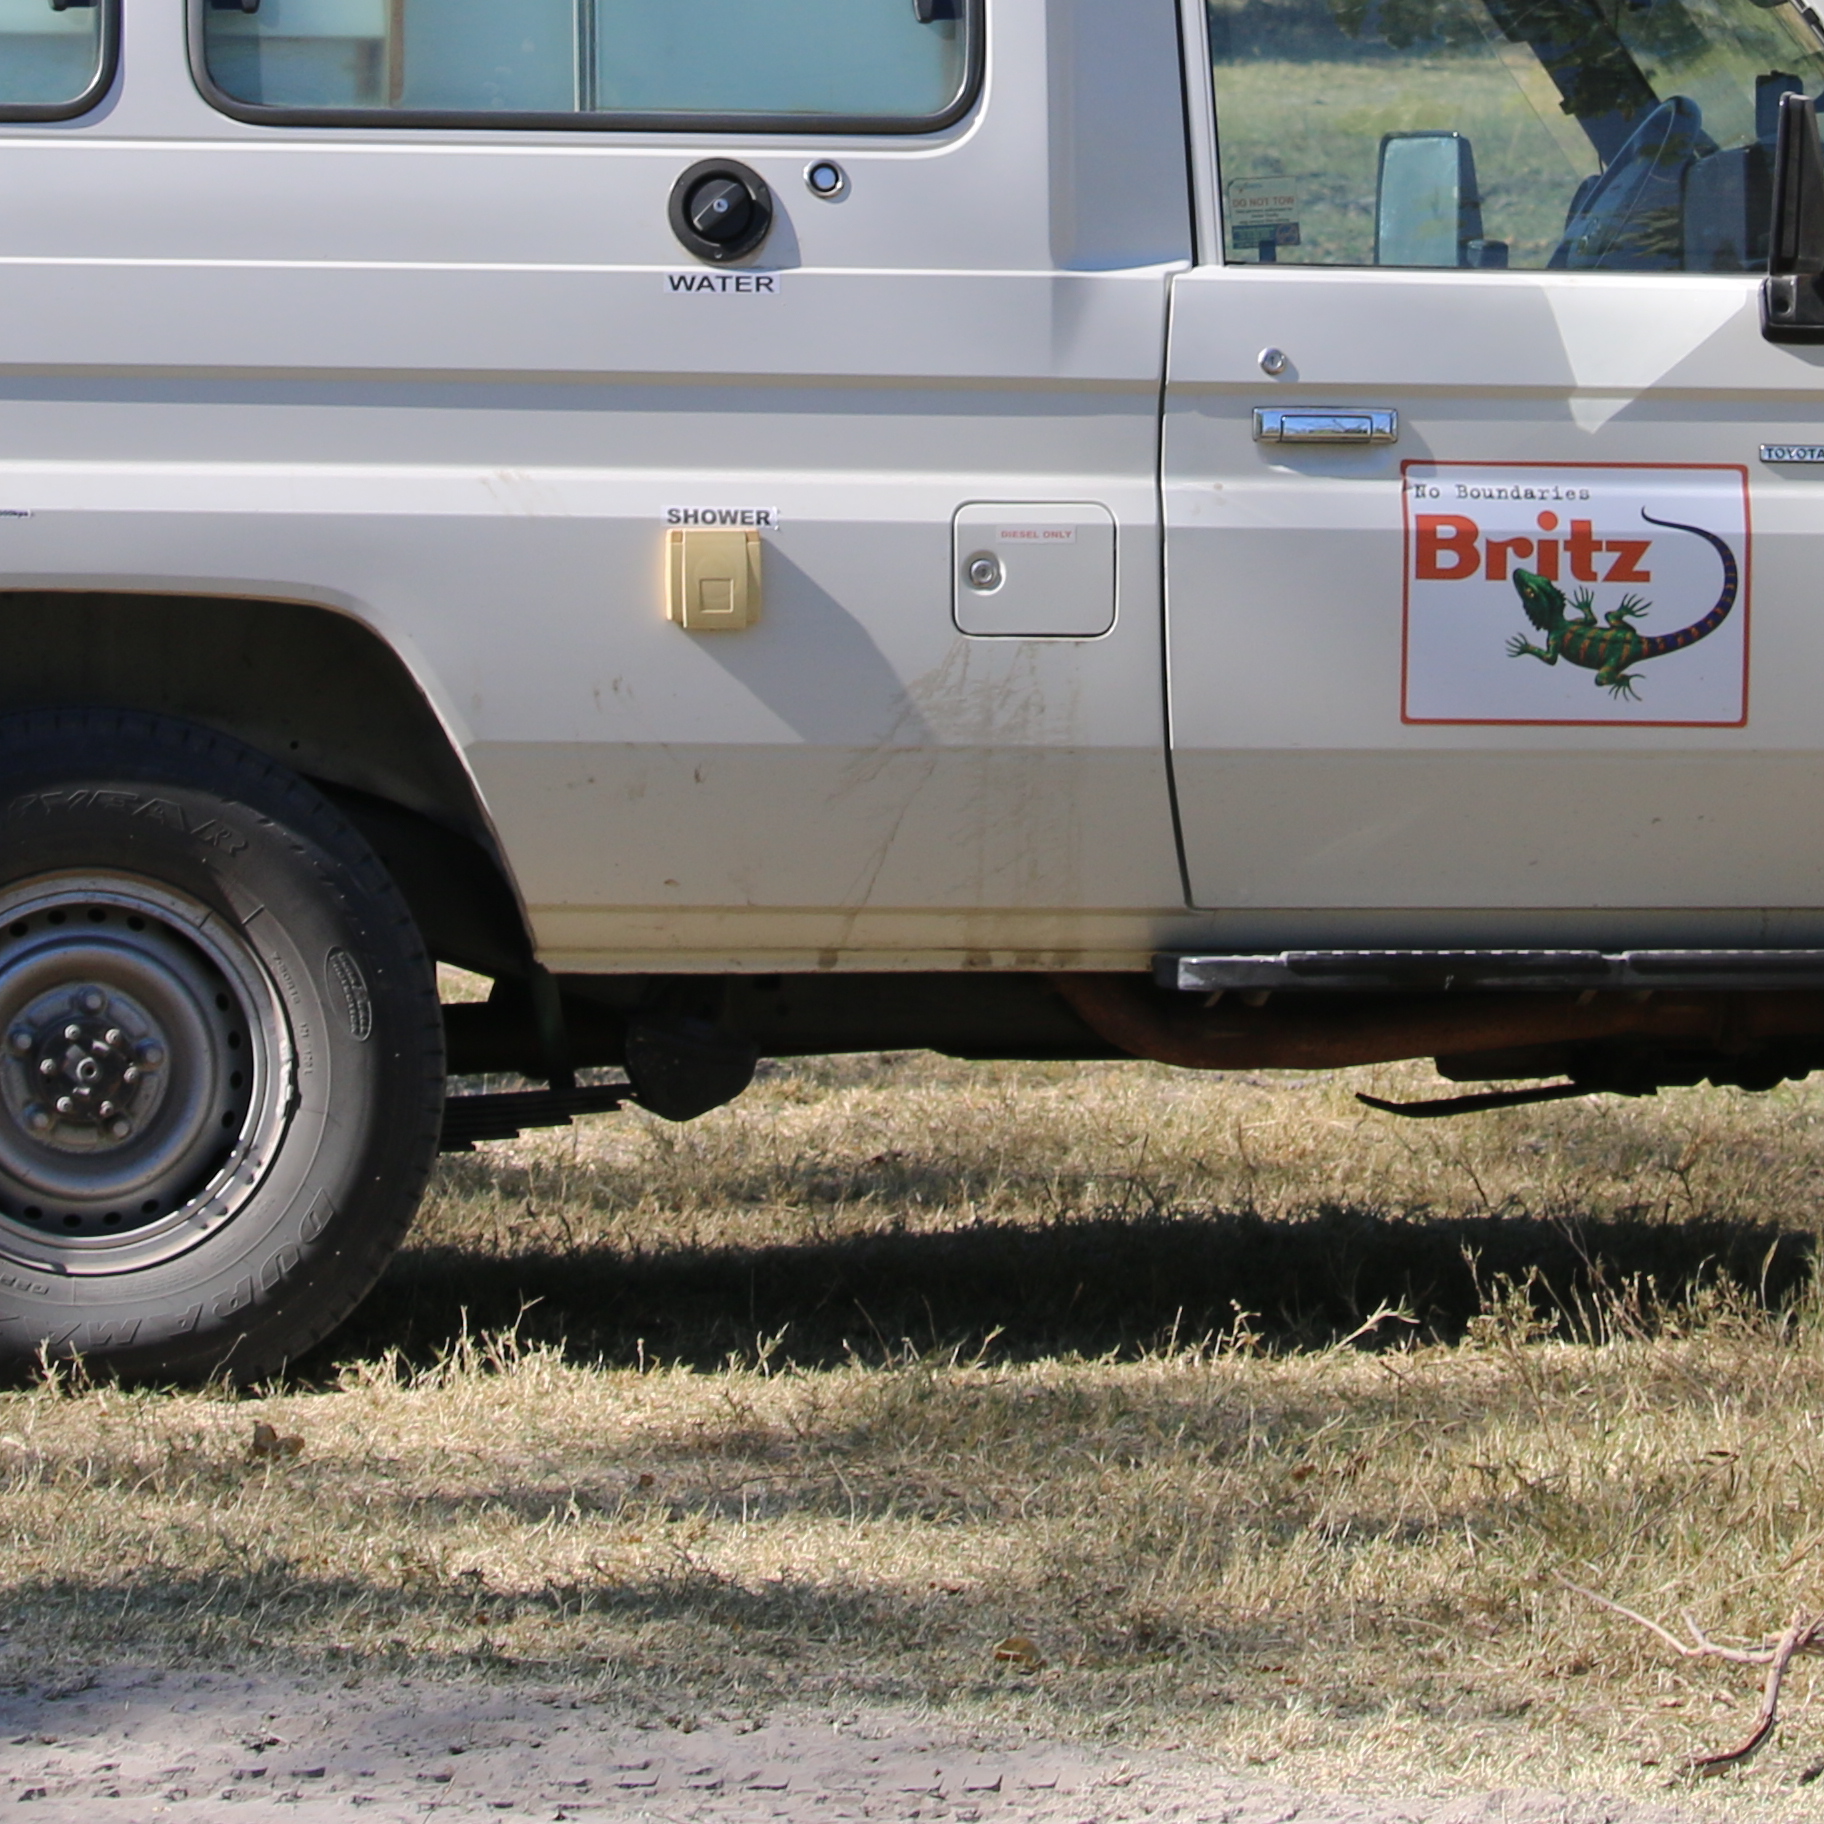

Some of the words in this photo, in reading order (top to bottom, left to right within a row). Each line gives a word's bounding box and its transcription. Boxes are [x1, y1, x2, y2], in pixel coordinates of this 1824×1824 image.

[668, 275, 775, 293] WATER
[1414, 484, 1441, 500] No
[1455, 483, 1591, 501] Boundaries
[666, 507, 772, 526] SHOWER
[1000, 530, 1040, 539] DIESEL
[1042, 530, 1072, 539] ONLY
[1414, 509, 1654, 583] Britz
